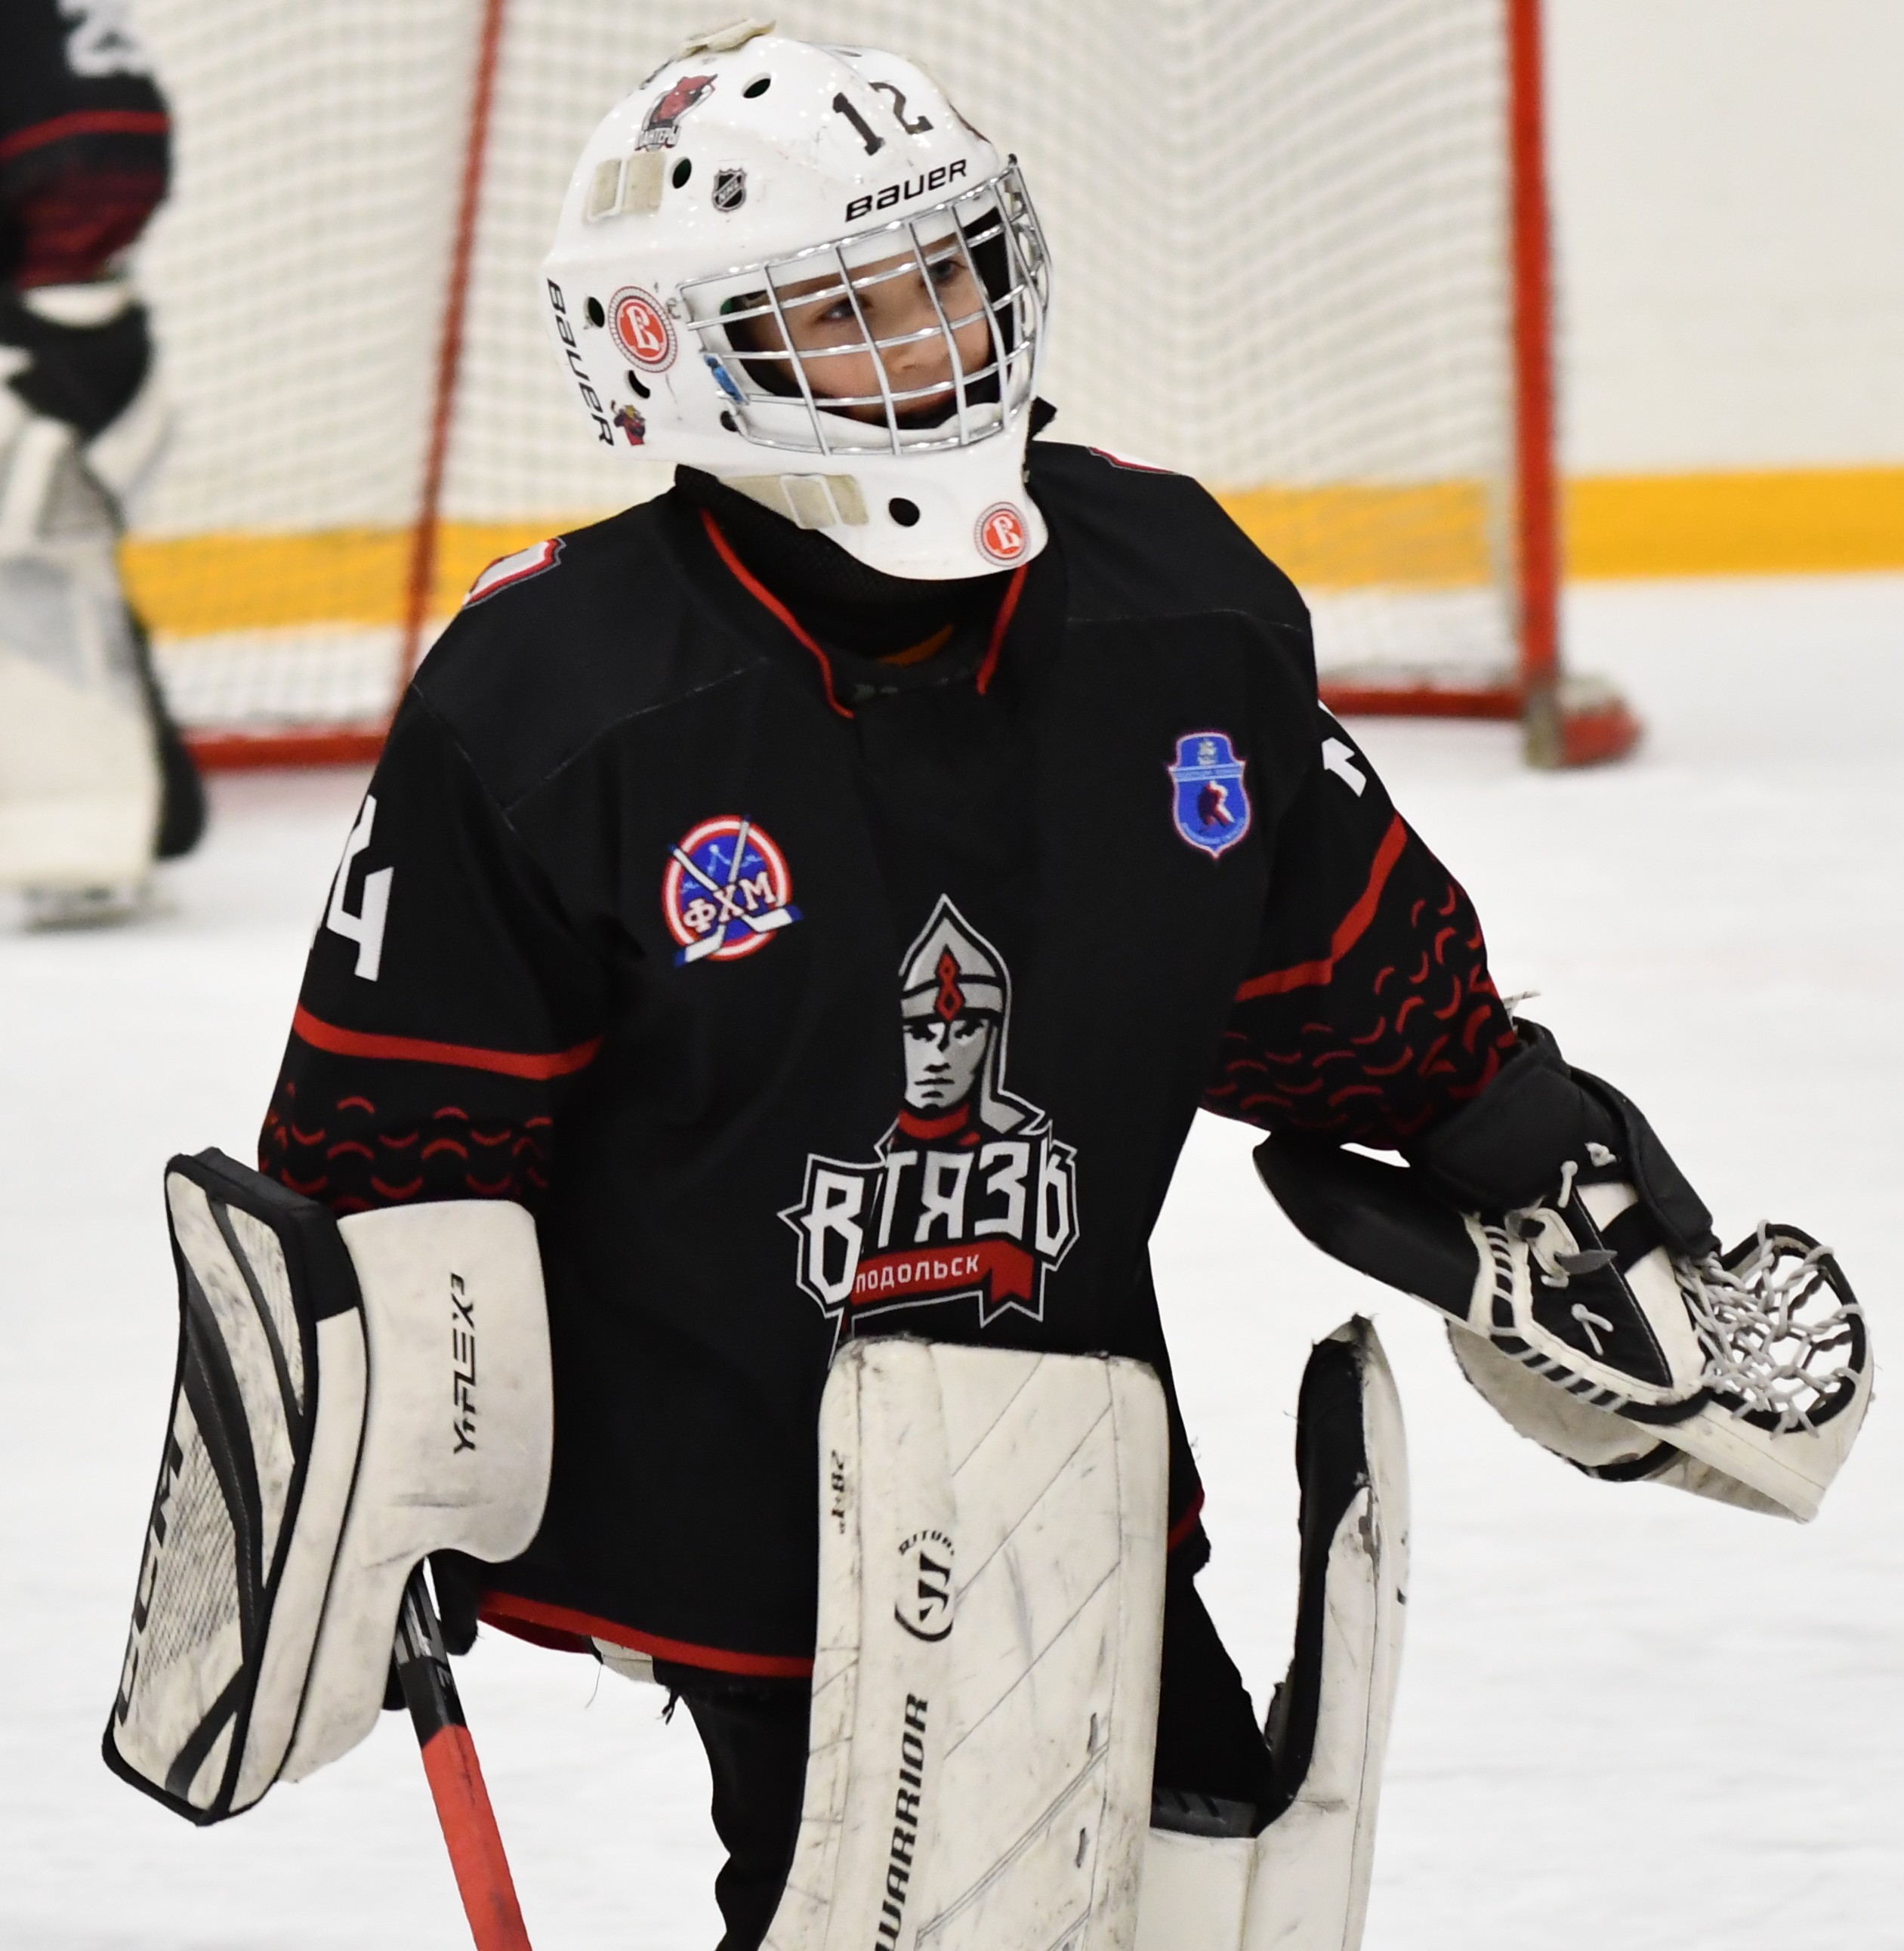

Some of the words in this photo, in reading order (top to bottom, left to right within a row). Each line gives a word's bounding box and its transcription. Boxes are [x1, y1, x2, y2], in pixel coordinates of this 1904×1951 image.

[833, 81, 934, 156] 12
[310, 793, 394, 982] 4
[683, 871, 777, 934] ФХМ
[800, 1137, 1070, 1304] ВТЯЗЬ
[856, 1254, 980, 1293] ПОДОЛЬСК
[875, 1693, 928, 1951] WARRIOR
